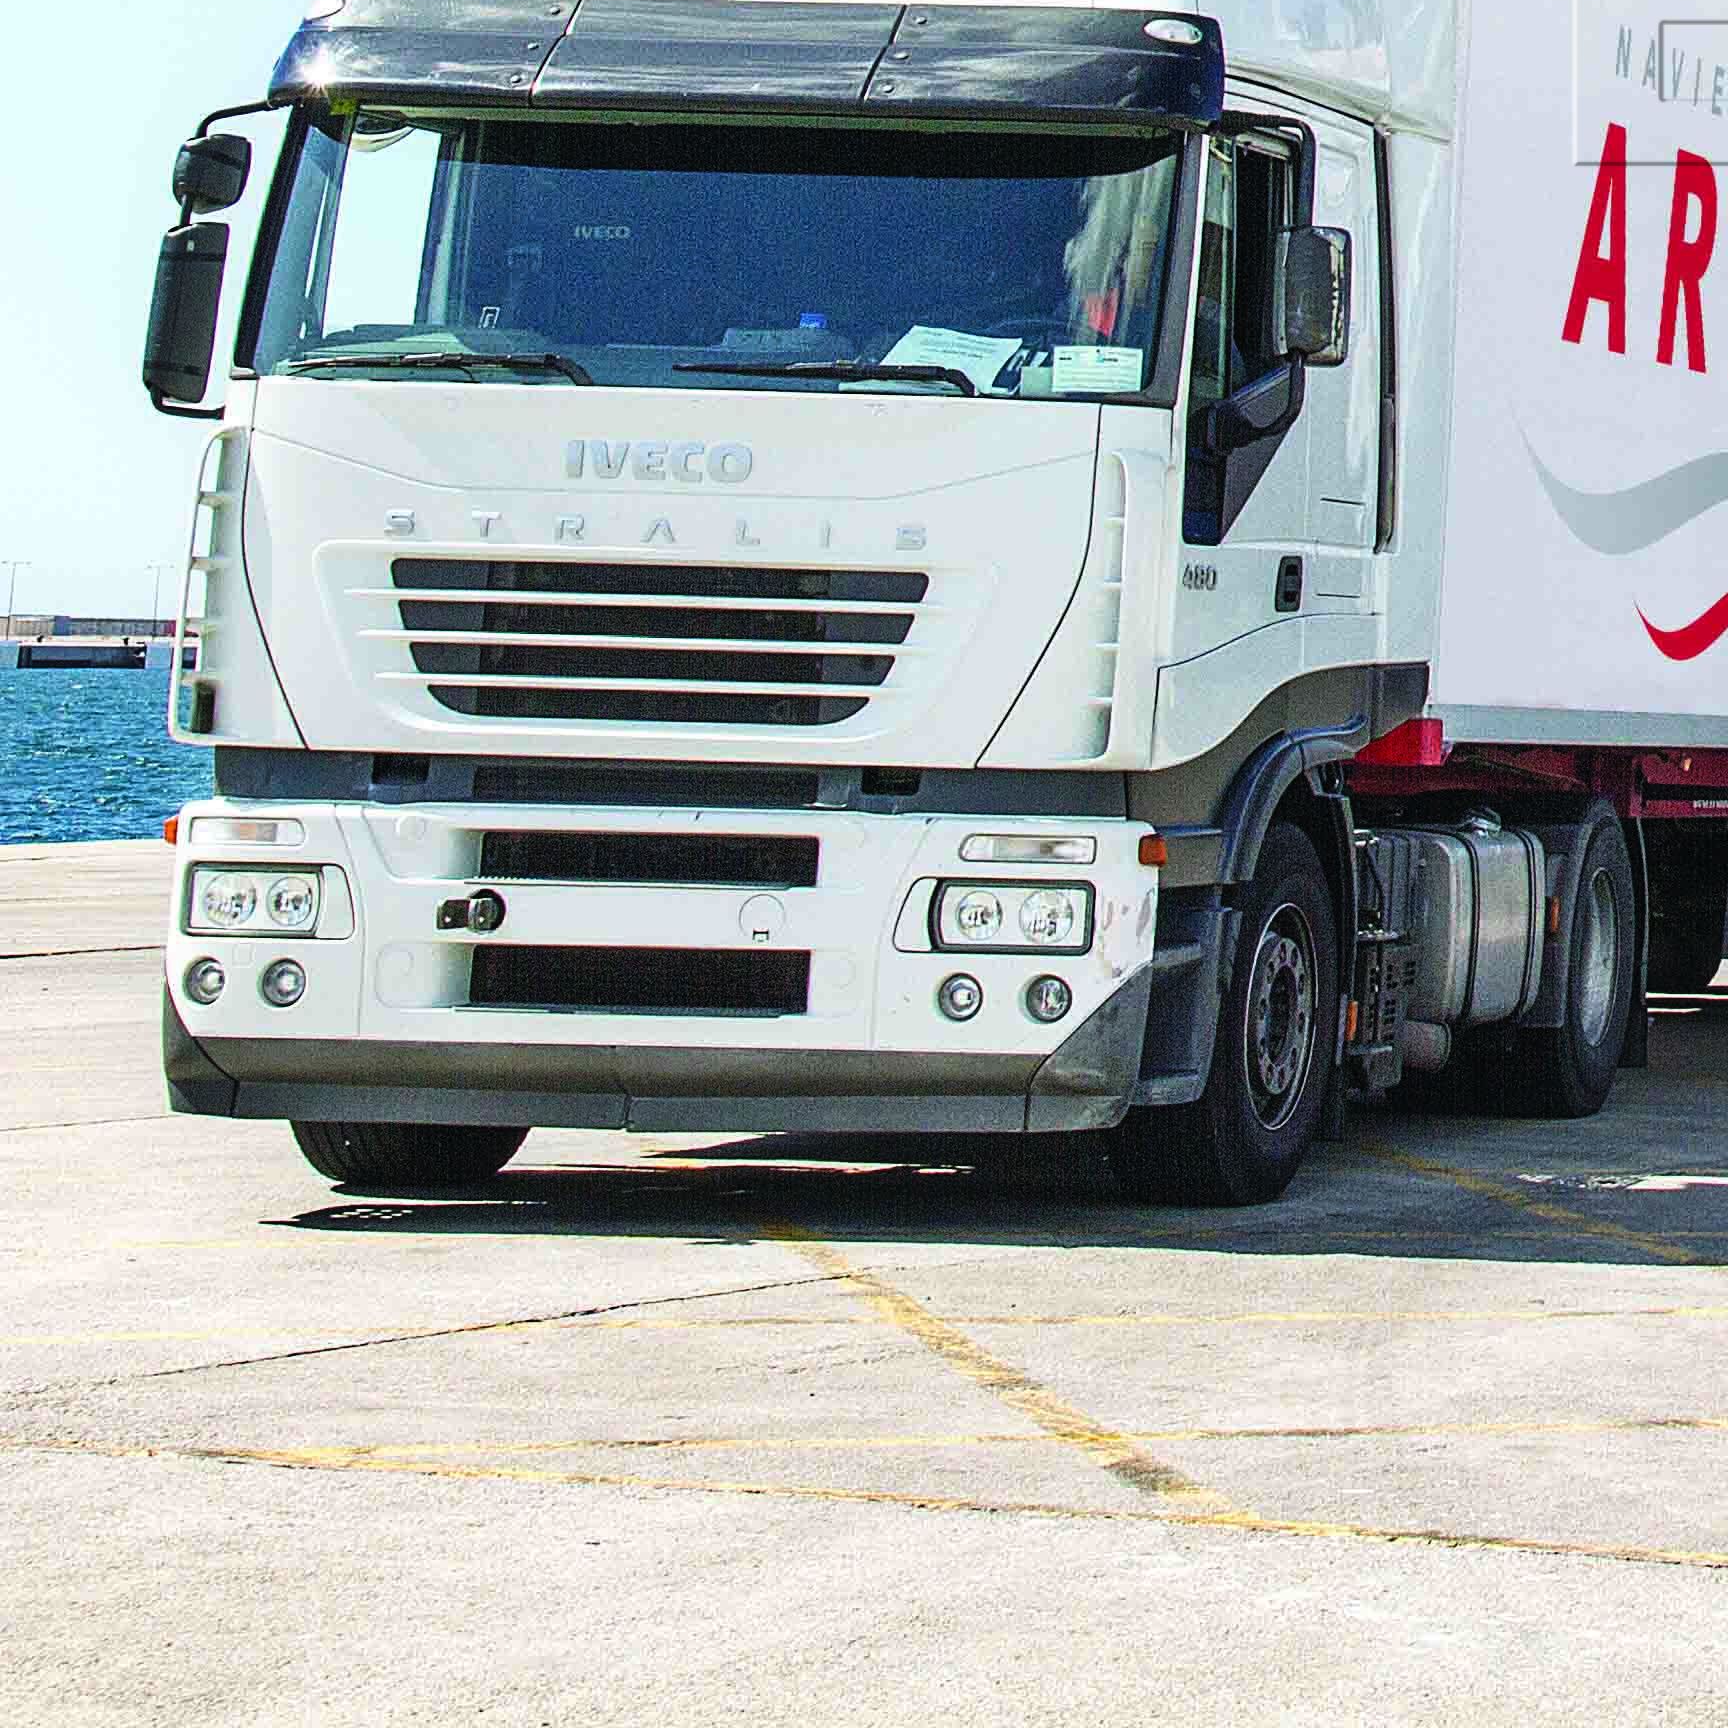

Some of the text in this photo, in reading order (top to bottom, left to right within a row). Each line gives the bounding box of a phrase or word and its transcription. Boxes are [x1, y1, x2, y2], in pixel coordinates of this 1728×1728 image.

[574, 224, 632, 240] IVECO
[563, 439, 753, 484] IVECO
[384, 509, 927, 550] STRALIS
